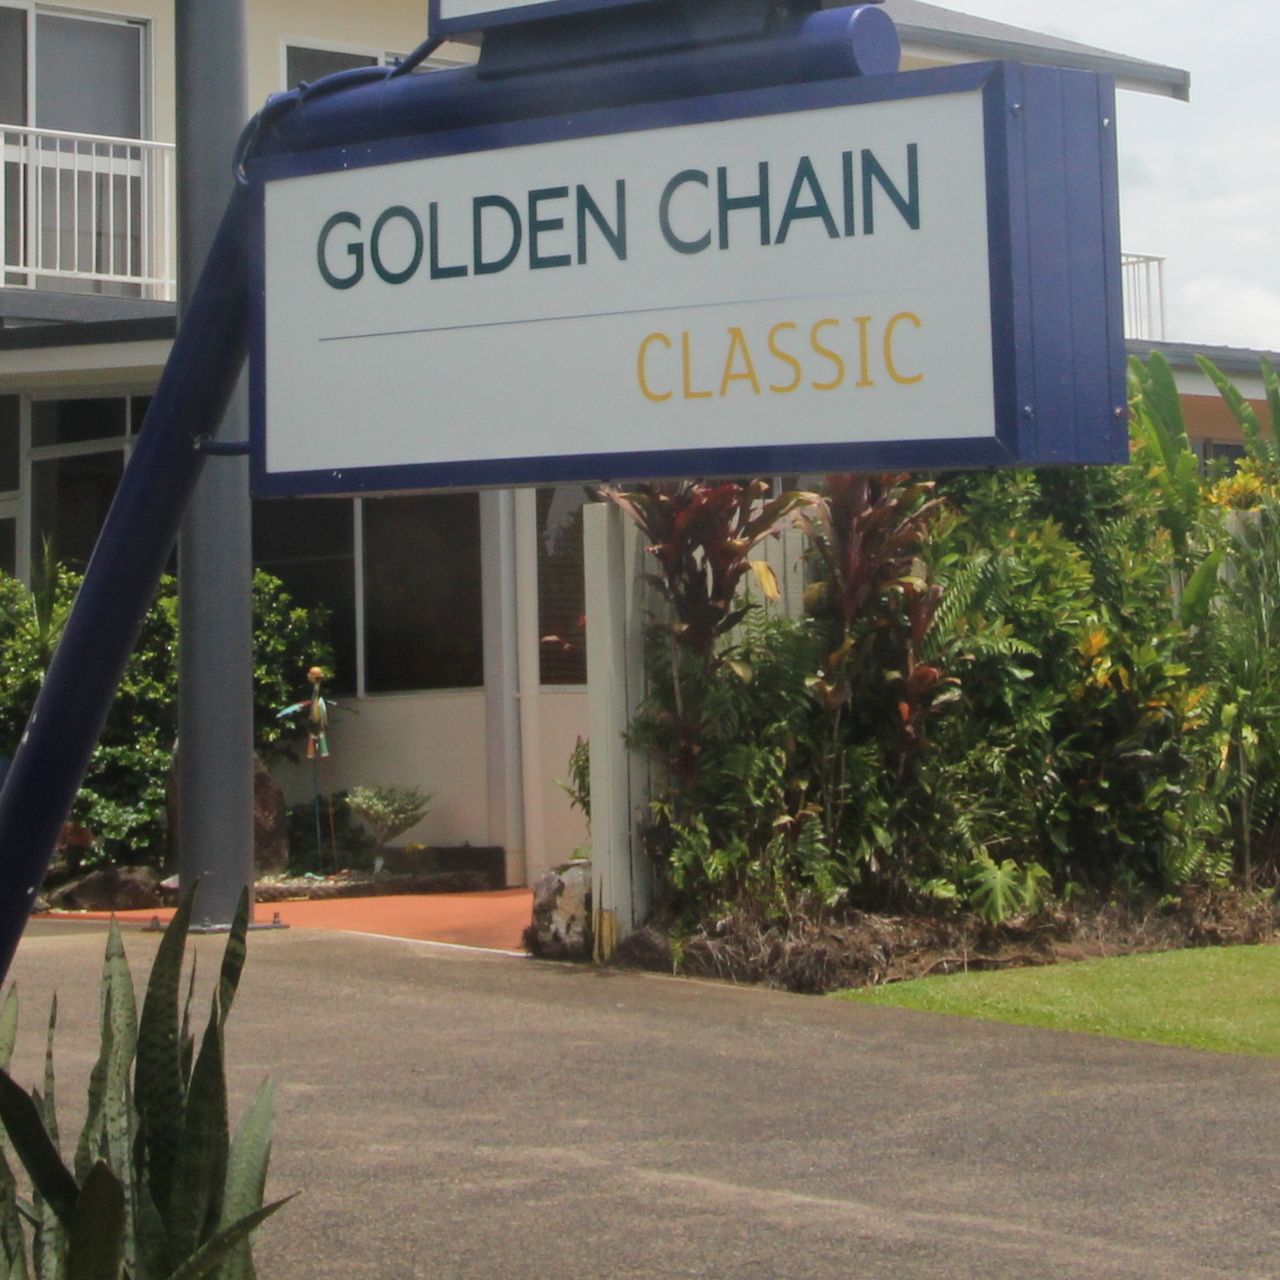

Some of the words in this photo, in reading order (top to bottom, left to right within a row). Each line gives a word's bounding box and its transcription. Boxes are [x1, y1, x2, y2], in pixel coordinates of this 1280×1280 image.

[317, 178, 629, 290] GOLDEN
[658, 142, 922, 255] CHAIN
[636, 310, 926, 403] CLASSIC
